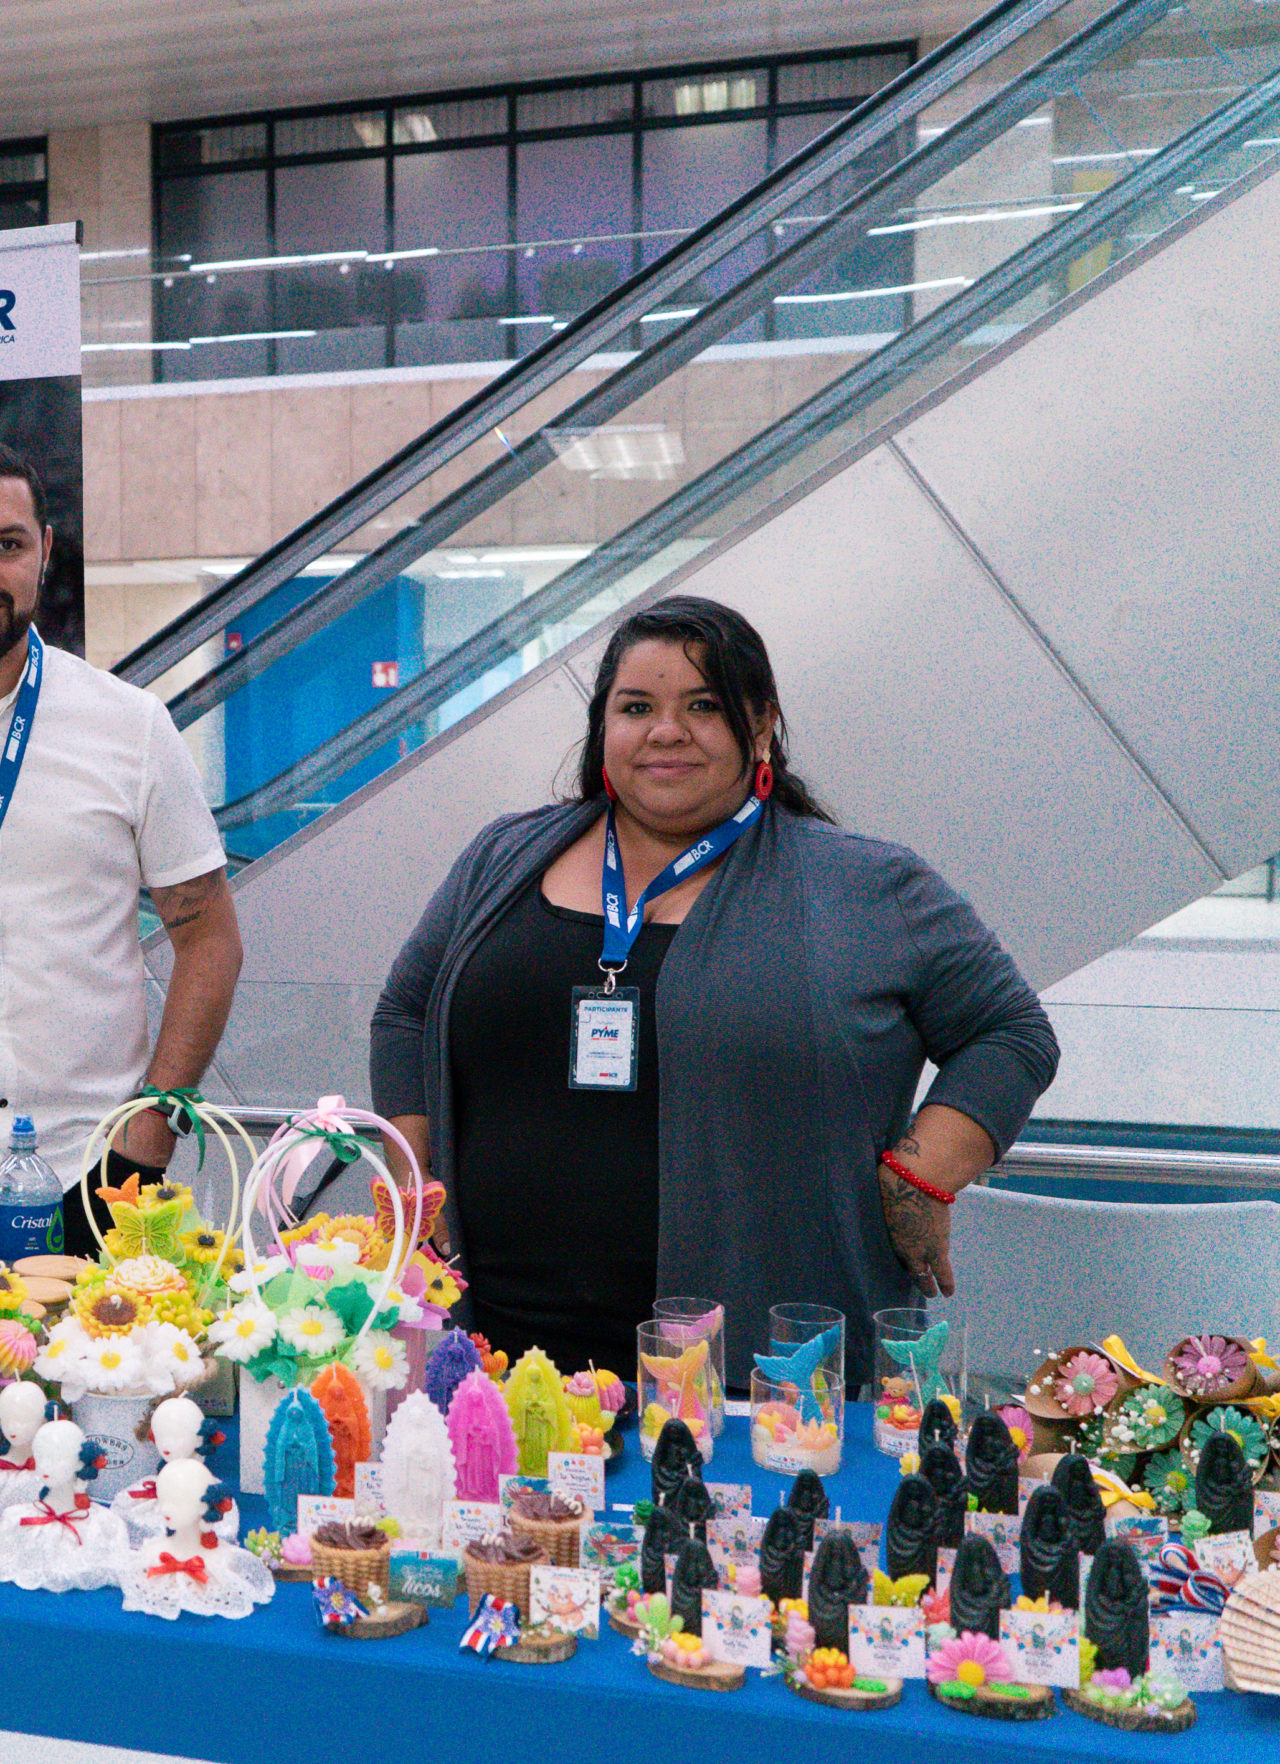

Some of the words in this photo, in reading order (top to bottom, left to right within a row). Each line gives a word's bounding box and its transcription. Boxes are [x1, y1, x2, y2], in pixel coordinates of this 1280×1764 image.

[31, 645, 40, 666] BCR
[12, 715, 26, 740] BCR
[690, 839, 714, 861] BCR
[606, 893, 619, 913] BCR
[591, 1028, 619, 1038] PYME
[11, 1213, 53, 1229] Cristal
